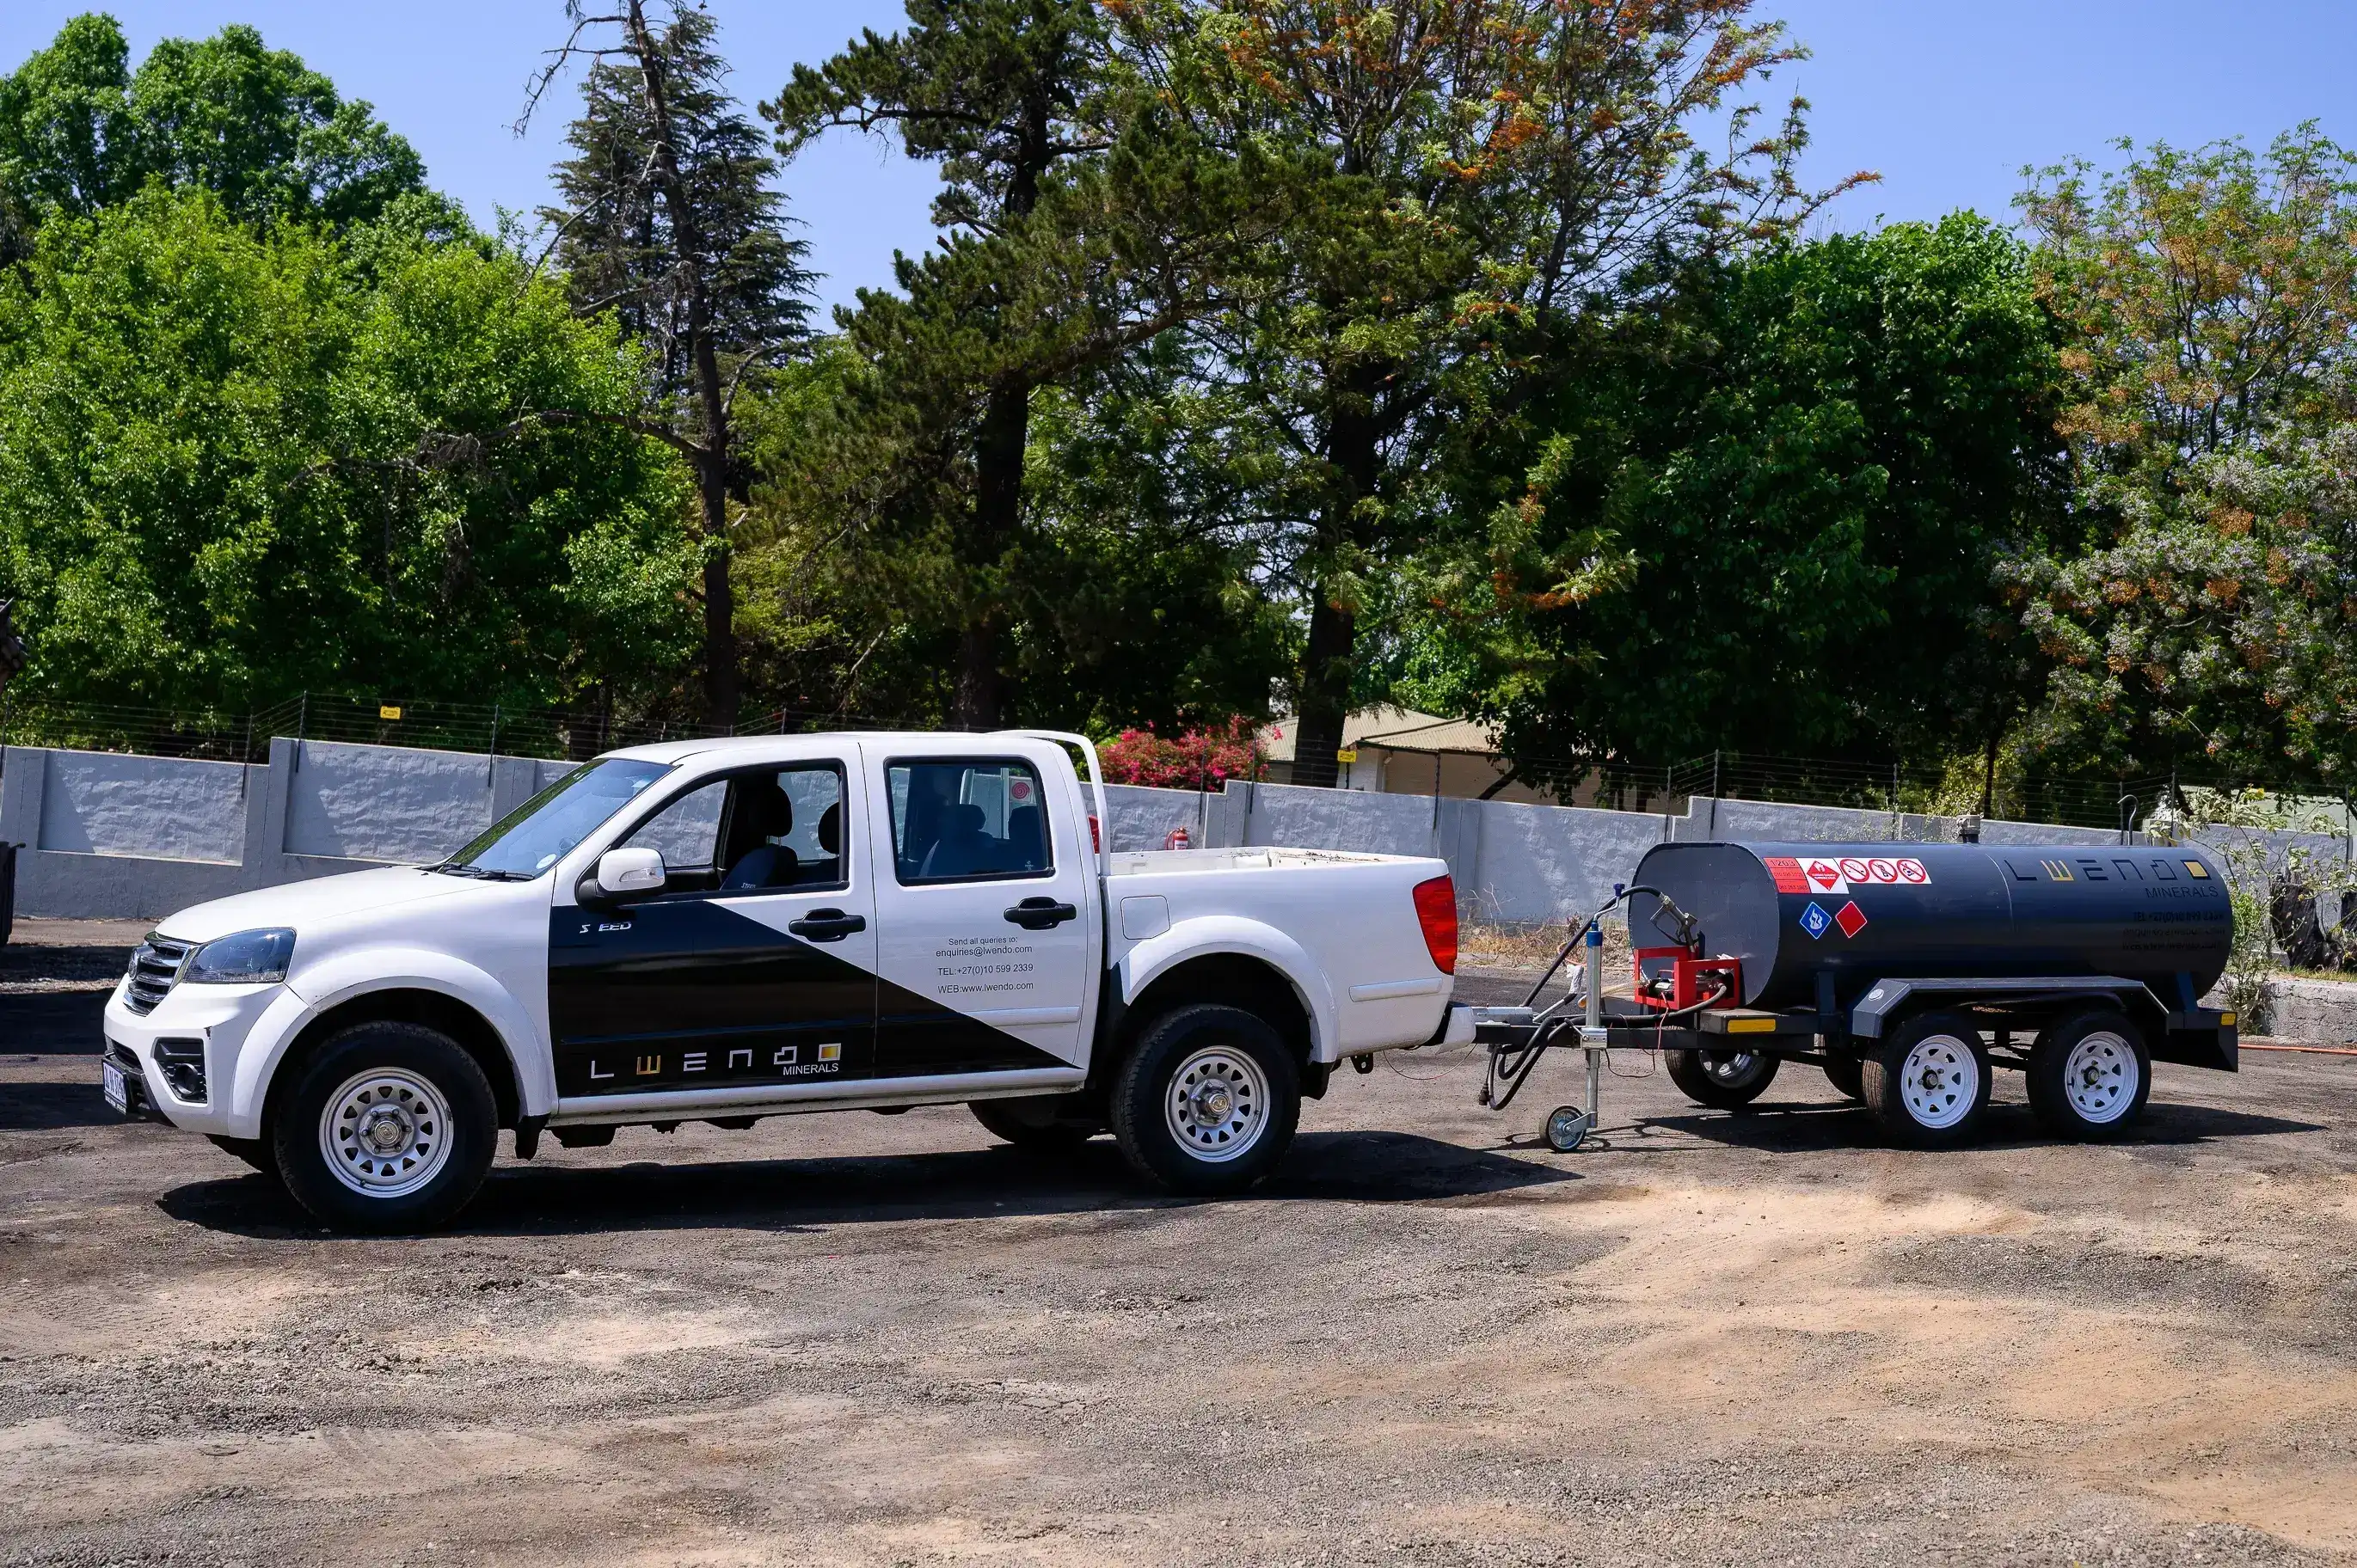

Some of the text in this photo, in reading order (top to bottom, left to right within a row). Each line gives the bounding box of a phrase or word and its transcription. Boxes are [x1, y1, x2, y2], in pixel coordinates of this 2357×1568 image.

[2145, 885, 2219, 898] MINERALS
[980, 936, 1007, 945] queries
[936, 946, 1033, 958] enquiries@lwendo.com
[937, 963, 1034, 976] TEL:+27(0)10 599 2339
[937, 982, 1034, 994] WEB:www.lwendo.com
[783, 1063, 839, 1076] MINERALS
